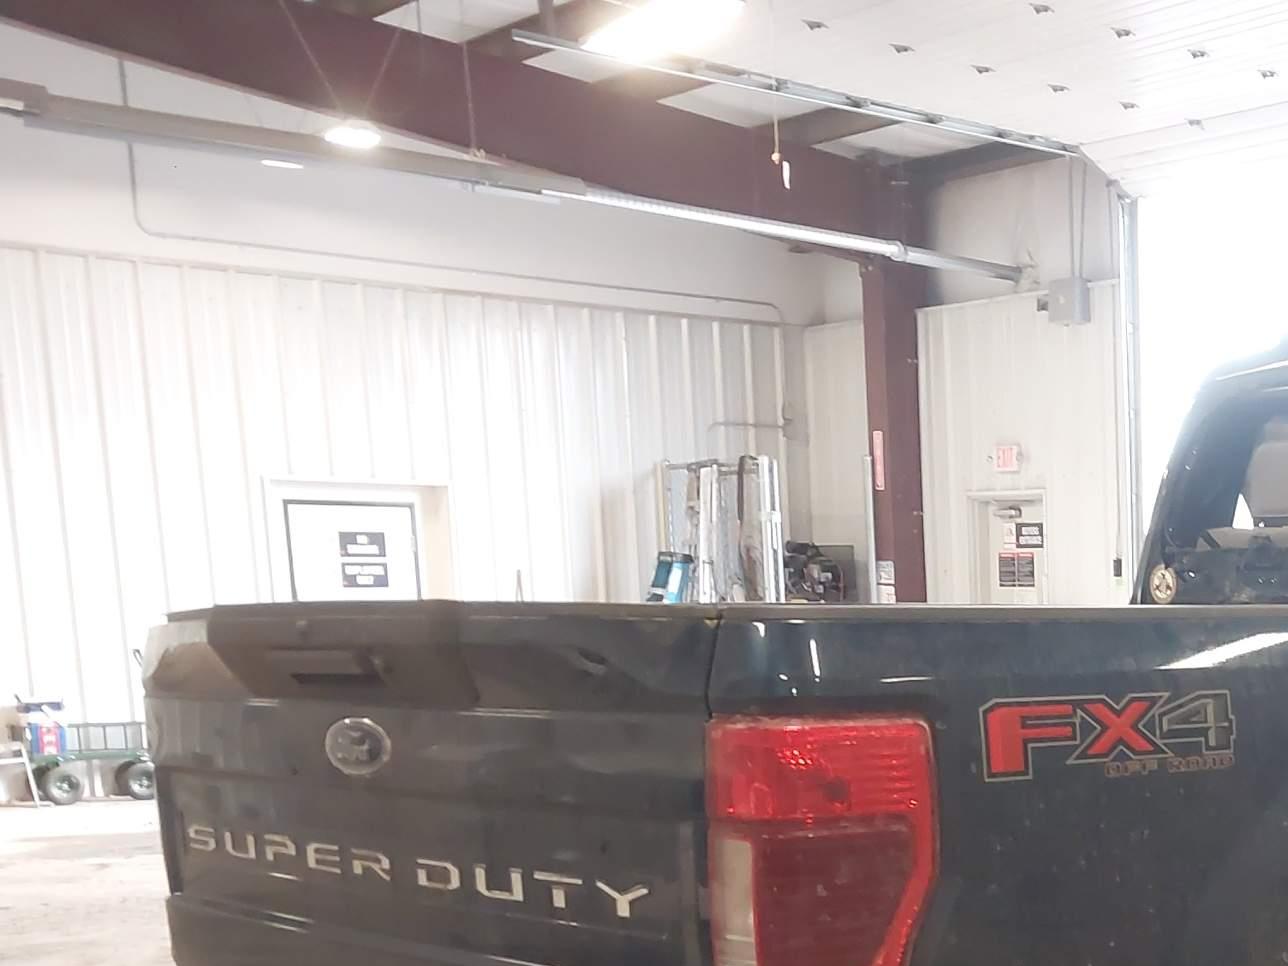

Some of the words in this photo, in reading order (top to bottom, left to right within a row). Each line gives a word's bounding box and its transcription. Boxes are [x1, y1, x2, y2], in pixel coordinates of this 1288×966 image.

[979, 689, 1236, 783] FX4
[187, 824, 391, 881] SUPER
[415, 857, 650, 919] DUTY
